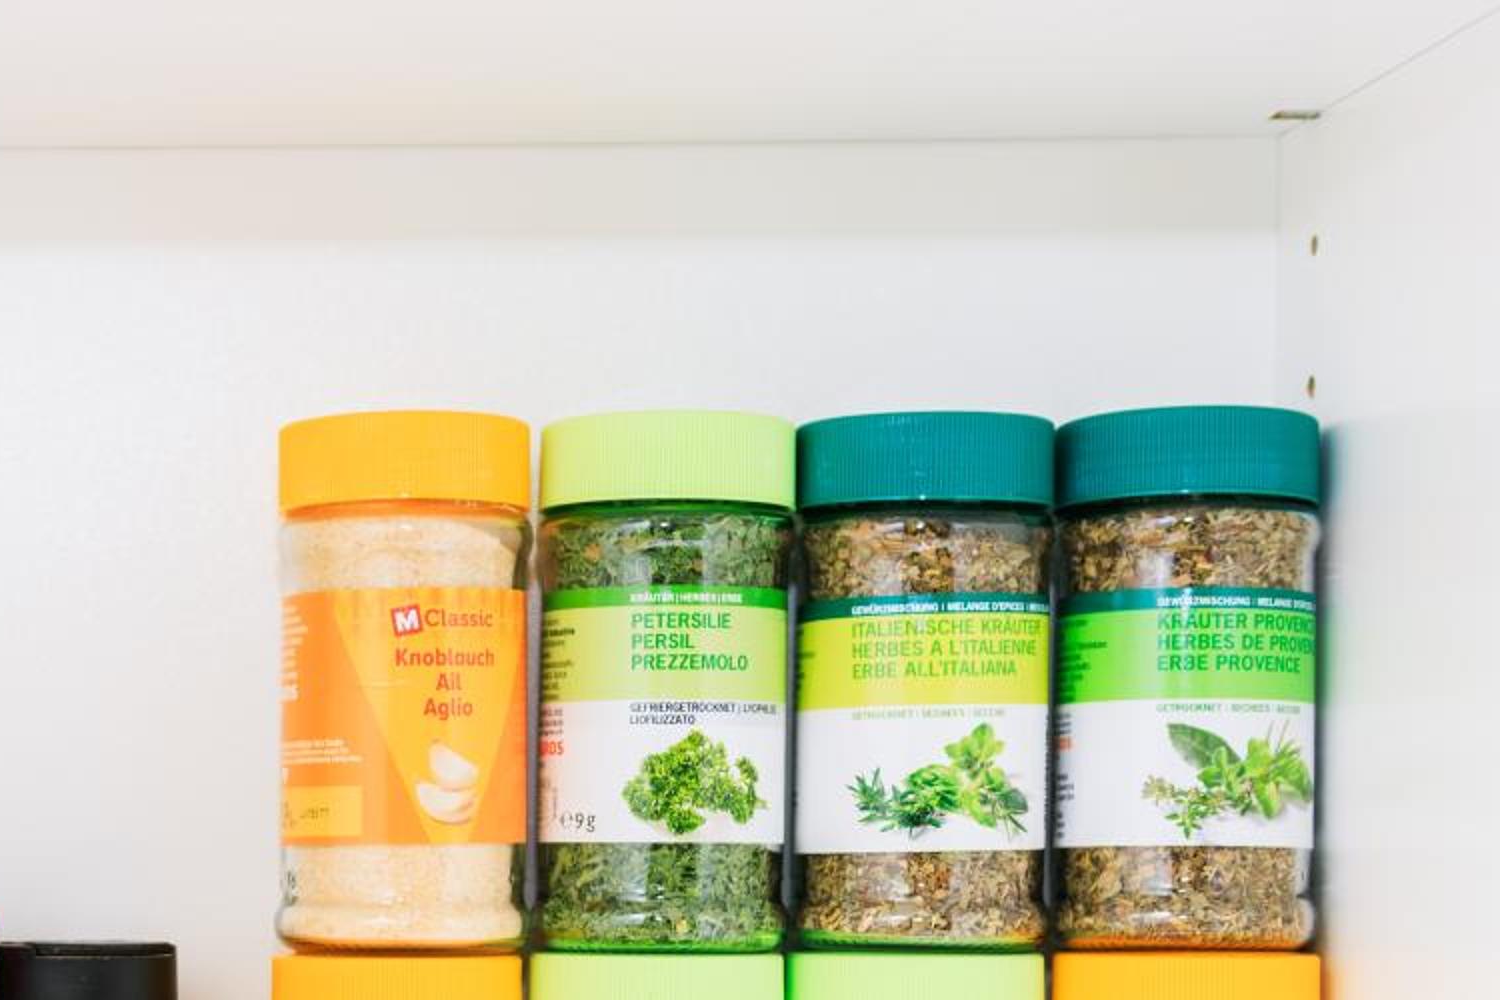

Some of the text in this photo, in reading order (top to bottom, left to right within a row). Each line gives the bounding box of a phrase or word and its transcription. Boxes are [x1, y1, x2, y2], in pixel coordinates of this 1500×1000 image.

[424, 609, 493, 628] Classic
[631, 612, 732, 629] PETERSILIE
[631, 633, 695, 649] PERSIL
[851, 640, 924, 659] HERBES
[1157, 633, 1235, 650] HERBES
[1242, 634, 1264, 651] DE
[394, 648, 495, 667] Knoblauch
[631, 653, 749, 671] PREZZEMOLO
[1157, 655, 1301, 673] ERBE PROVENCE
[851, 660, 1018, 680] ERBE ALL'ITALIANA
[435, 673, 463, 691] Ail
[423, 698, 474, 721] Aglio
